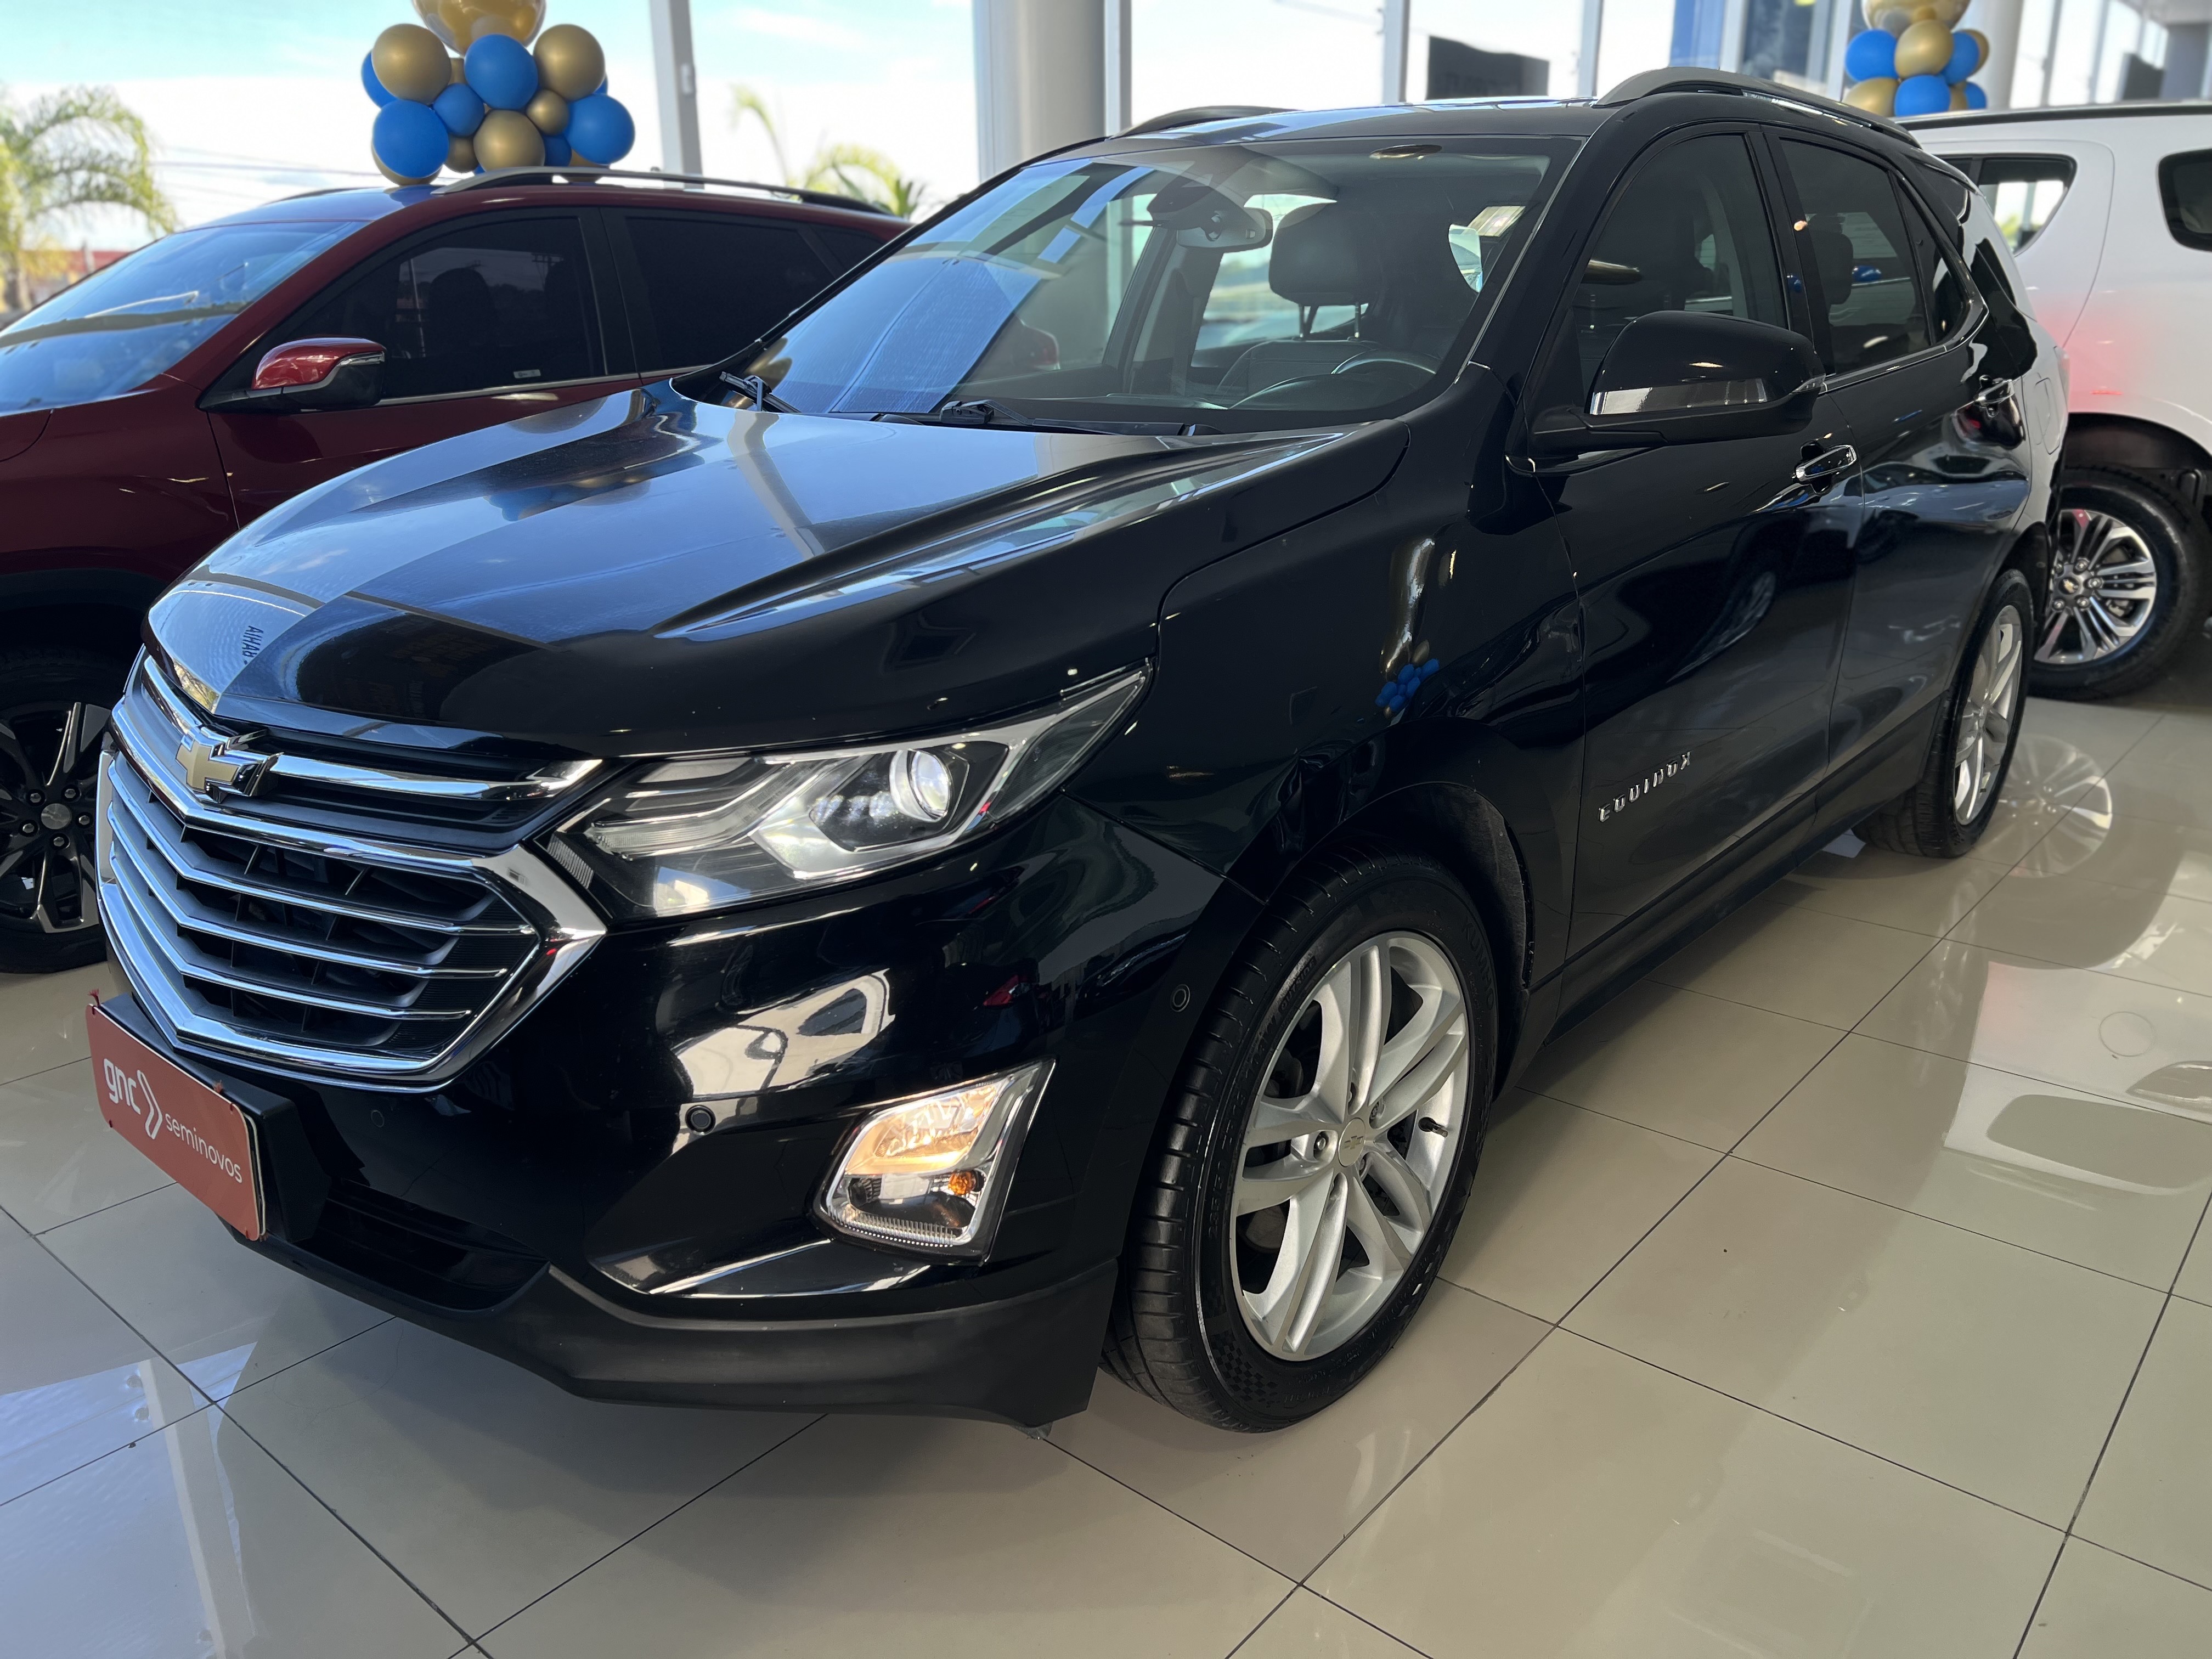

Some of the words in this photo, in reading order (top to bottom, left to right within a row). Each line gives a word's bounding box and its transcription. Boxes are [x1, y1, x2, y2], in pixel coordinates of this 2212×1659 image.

[1599, 751, 1690, 823] EQUINOX
[1280, 958, 1317, 1011] OUTSIDE
[1463, 917, 1494, 1011] KUMHO
[103, 1058, 141, 1115] gnc
[165, 1113, 242, 1184] seminovos
